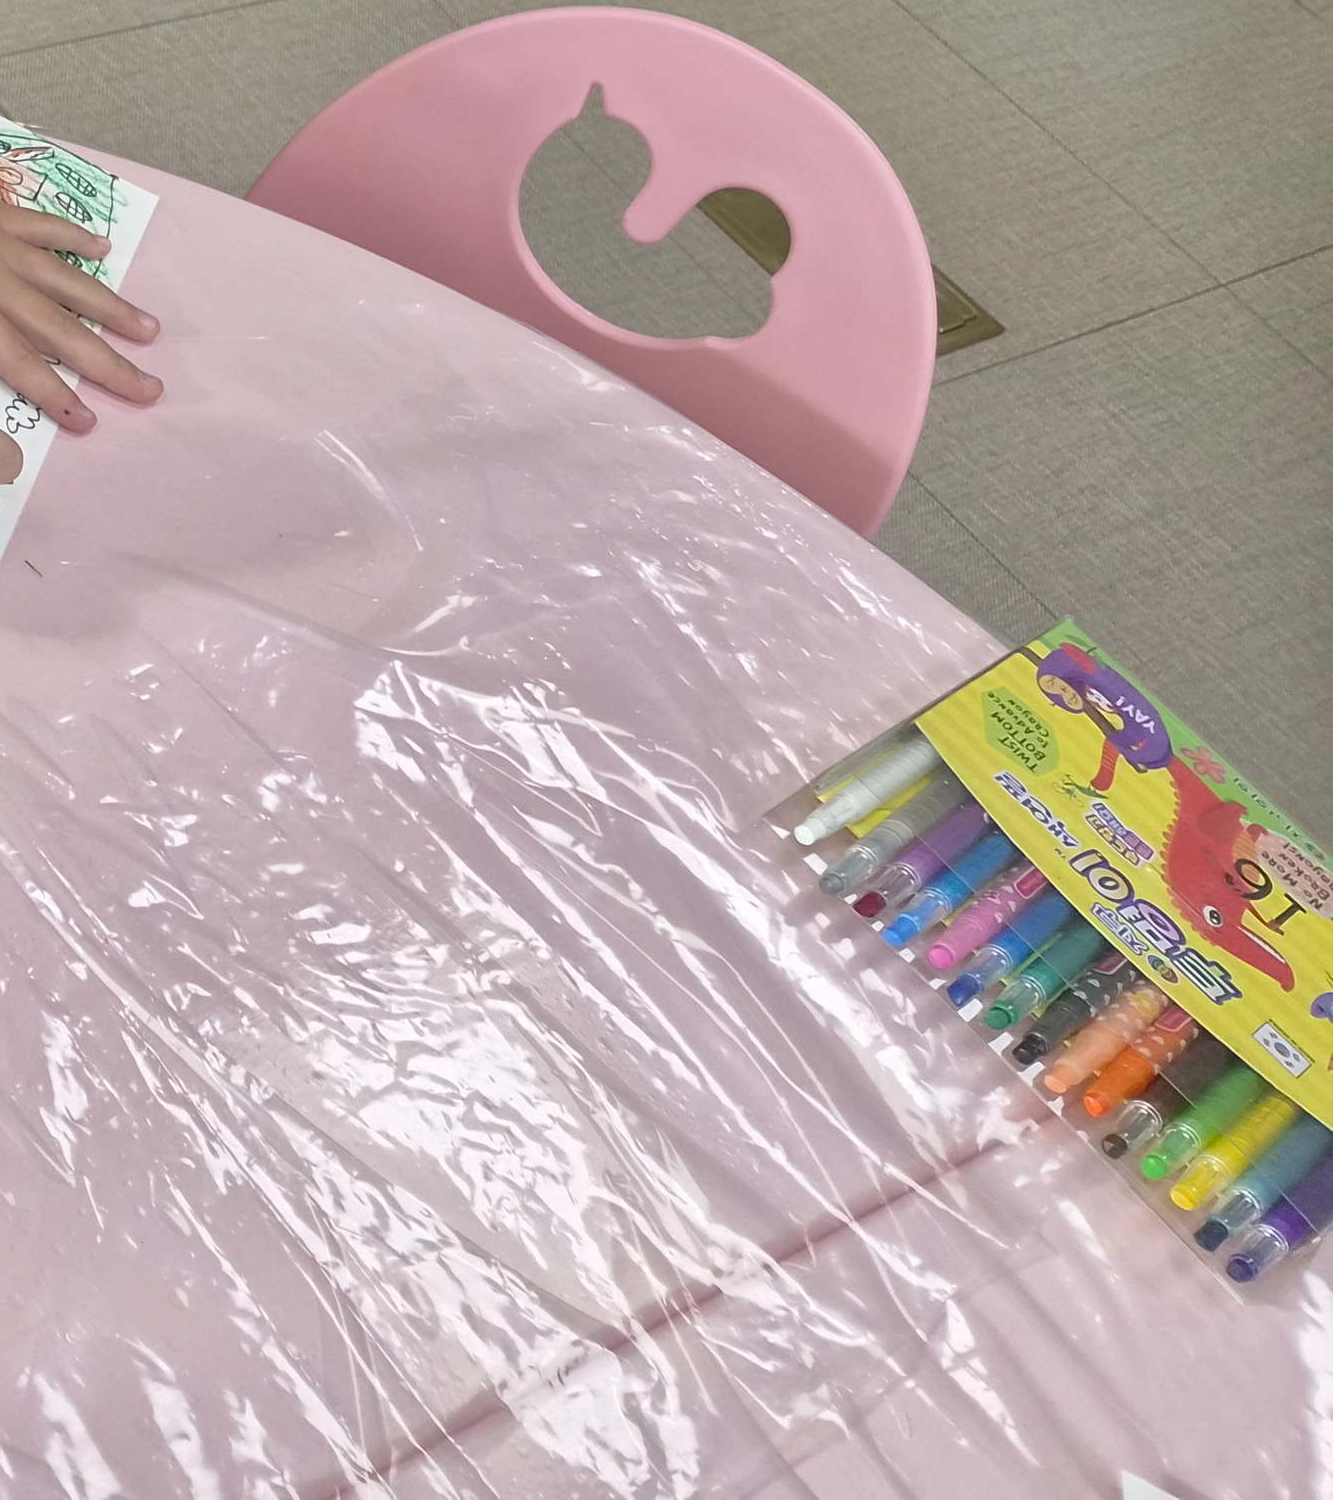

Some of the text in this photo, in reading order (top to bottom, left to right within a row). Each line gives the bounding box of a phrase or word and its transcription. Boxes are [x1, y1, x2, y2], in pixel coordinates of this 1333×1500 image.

[990, 711, 1046, 761] BOTTOM
[1116, 696, 1156, 733] YAY!
[997, 736, 1038, 773] TWIST
[994, 770, 1079, 847] 색연필
[1225, 858, 1307, 936] 16
[1069, 849, 1242, 1005] 투명이
[1091, 902, 1149, 955] 지구
